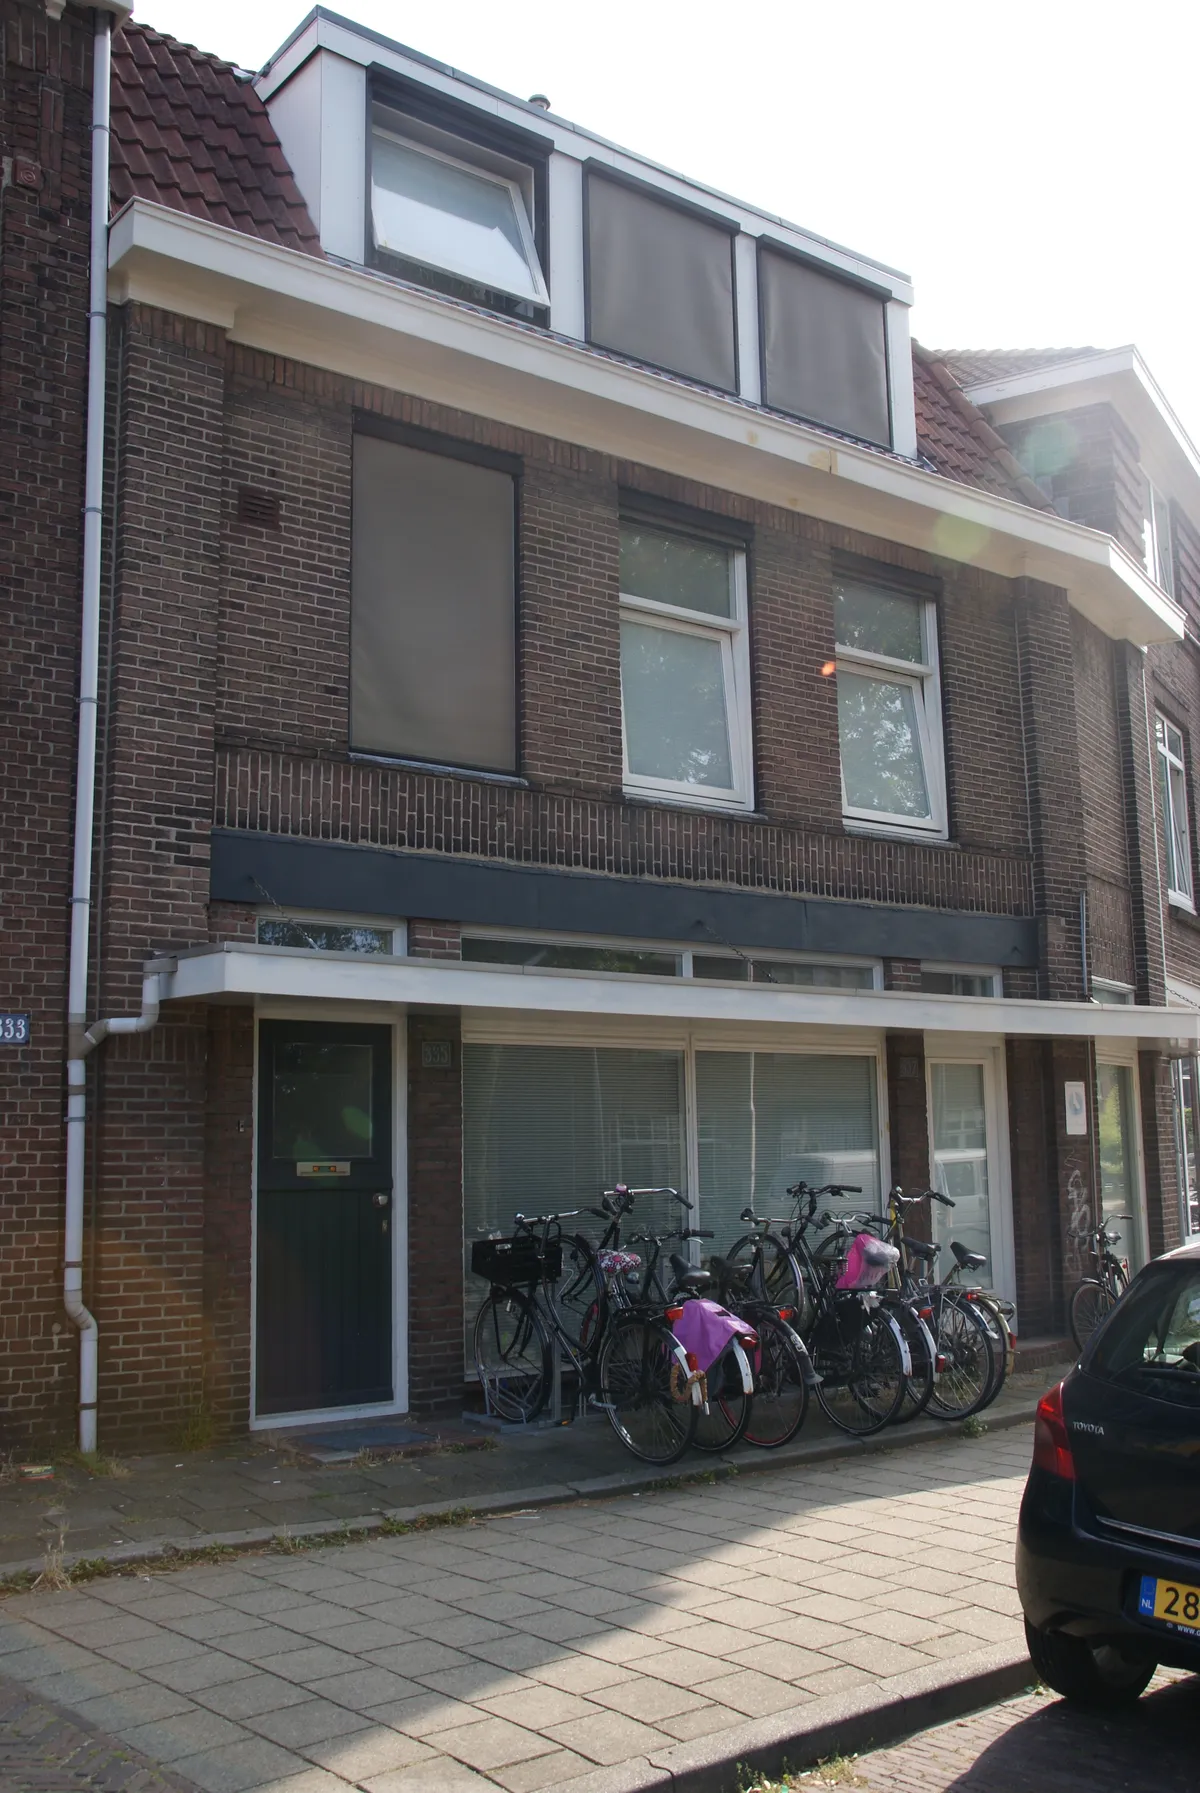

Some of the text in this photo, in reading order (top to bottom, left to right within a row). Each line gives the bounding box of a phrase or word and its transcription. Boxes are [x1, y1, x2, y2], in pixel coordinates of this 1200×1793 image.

[1072, 1421, 1104, 1435] TOYOTA
[1141, 1598, 1153, 1610] NL
[1163, 1586, 1200, 1621] 28
